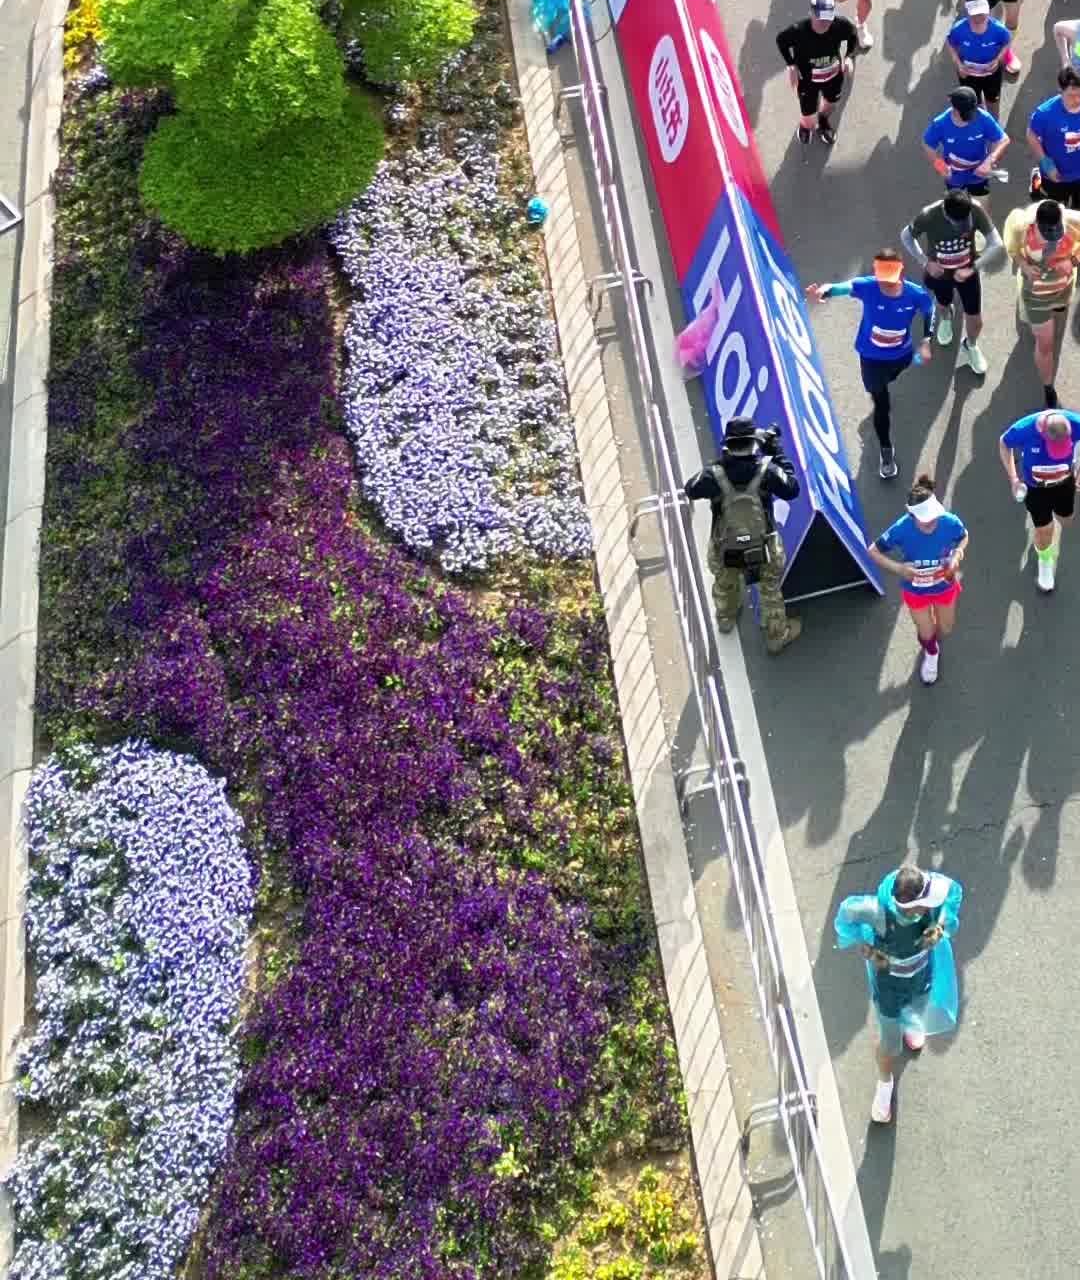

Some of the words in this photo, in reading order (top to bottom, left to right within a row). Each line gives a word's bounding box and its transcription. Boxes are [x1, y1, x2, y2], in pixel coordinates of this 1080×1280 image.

[654, 56, 684, 147] 小红书
[757, 231, 869, 549] Haier
